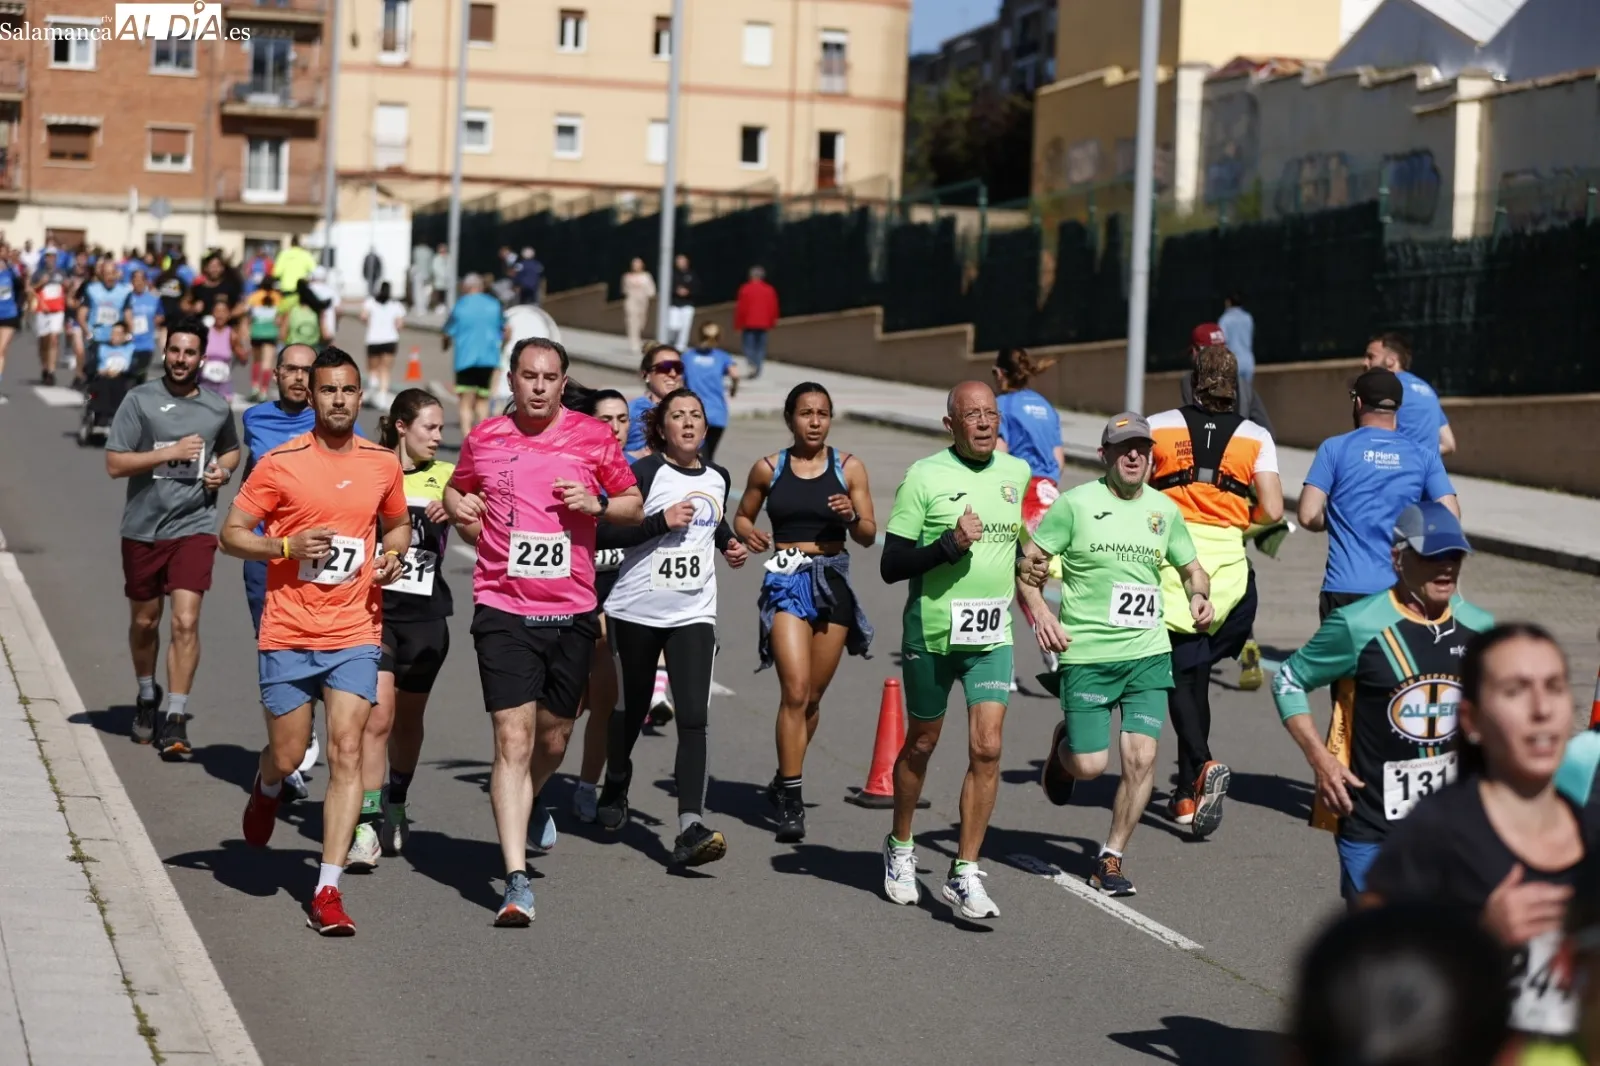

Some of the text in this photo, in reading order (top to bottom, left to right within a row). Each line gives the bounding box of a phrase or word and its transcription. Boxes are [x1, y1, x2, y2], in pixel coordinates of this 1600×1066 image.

[497, 470, 513, 504] 2024
[983, 522, 1018, 533] AXIMO
[517, 541, 564, 567] 228
[1089, 543, 1161, 558] SANMAXIMO
[659, 555, 700, 579] 458
[1118, 592, 1155, 617] 224
[960, 607, 1001, 632] 290
[1397, 766, 1447, 801] 131
